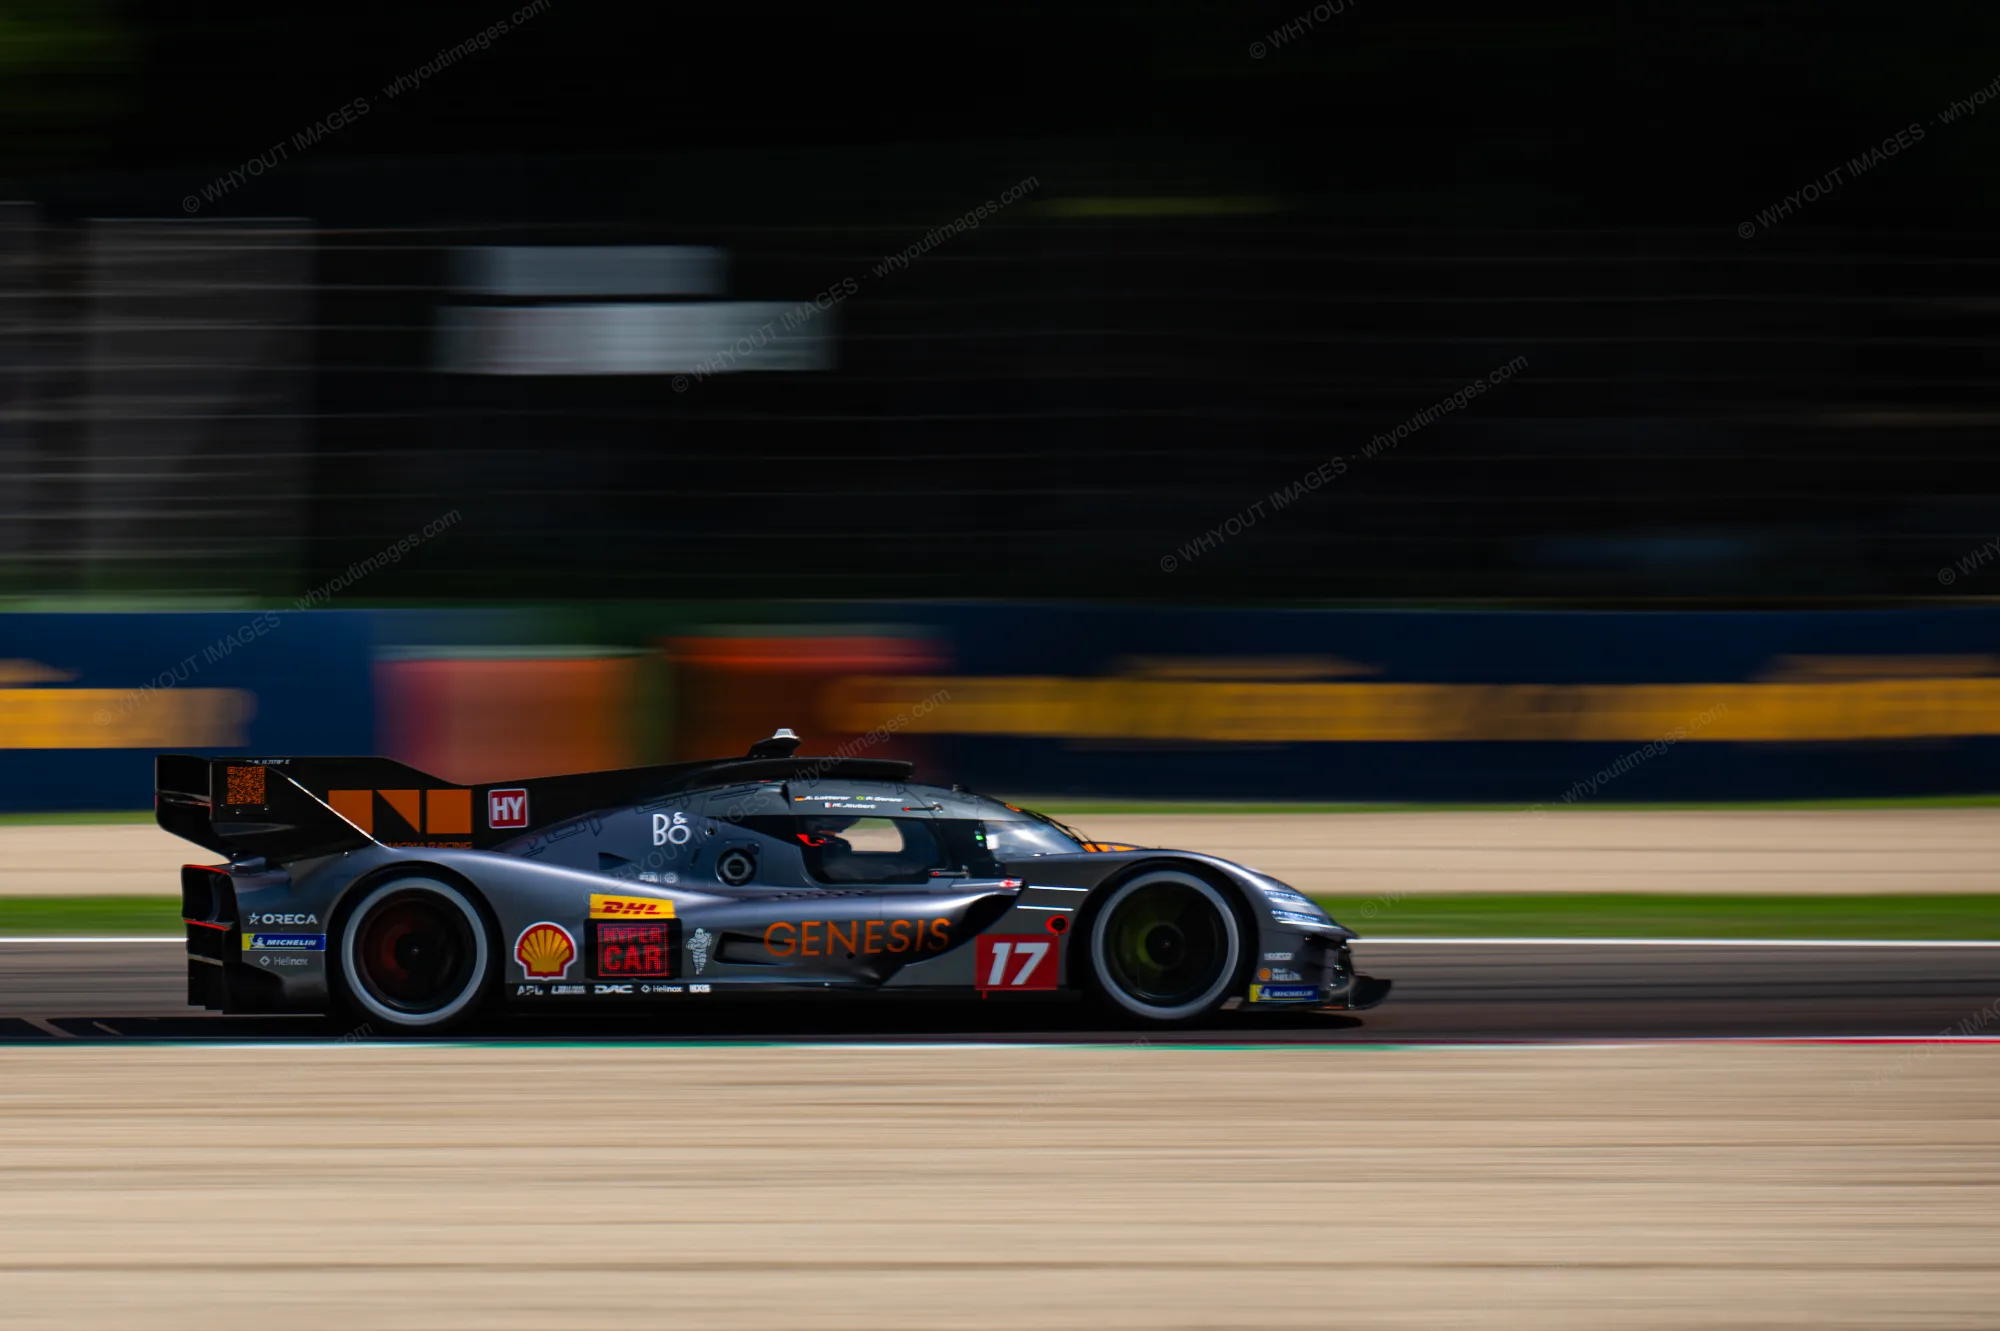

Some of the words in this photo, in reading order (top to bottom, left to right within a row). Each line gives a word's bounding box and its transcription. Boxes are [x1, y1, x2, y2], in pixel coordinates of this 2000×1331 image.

[491, 796, 524, 821] HY
[602, 901, 661, 915] DHL
[262, 913, 318, 924] ORECA
[603, 927, 661, 943] HYPER
[763, 917, 951, 957] GENESIS
[603, 944, 661, 972] CAR
[987, 942, 1049, 985] 17
[594, 984, 634, 994] DAC
